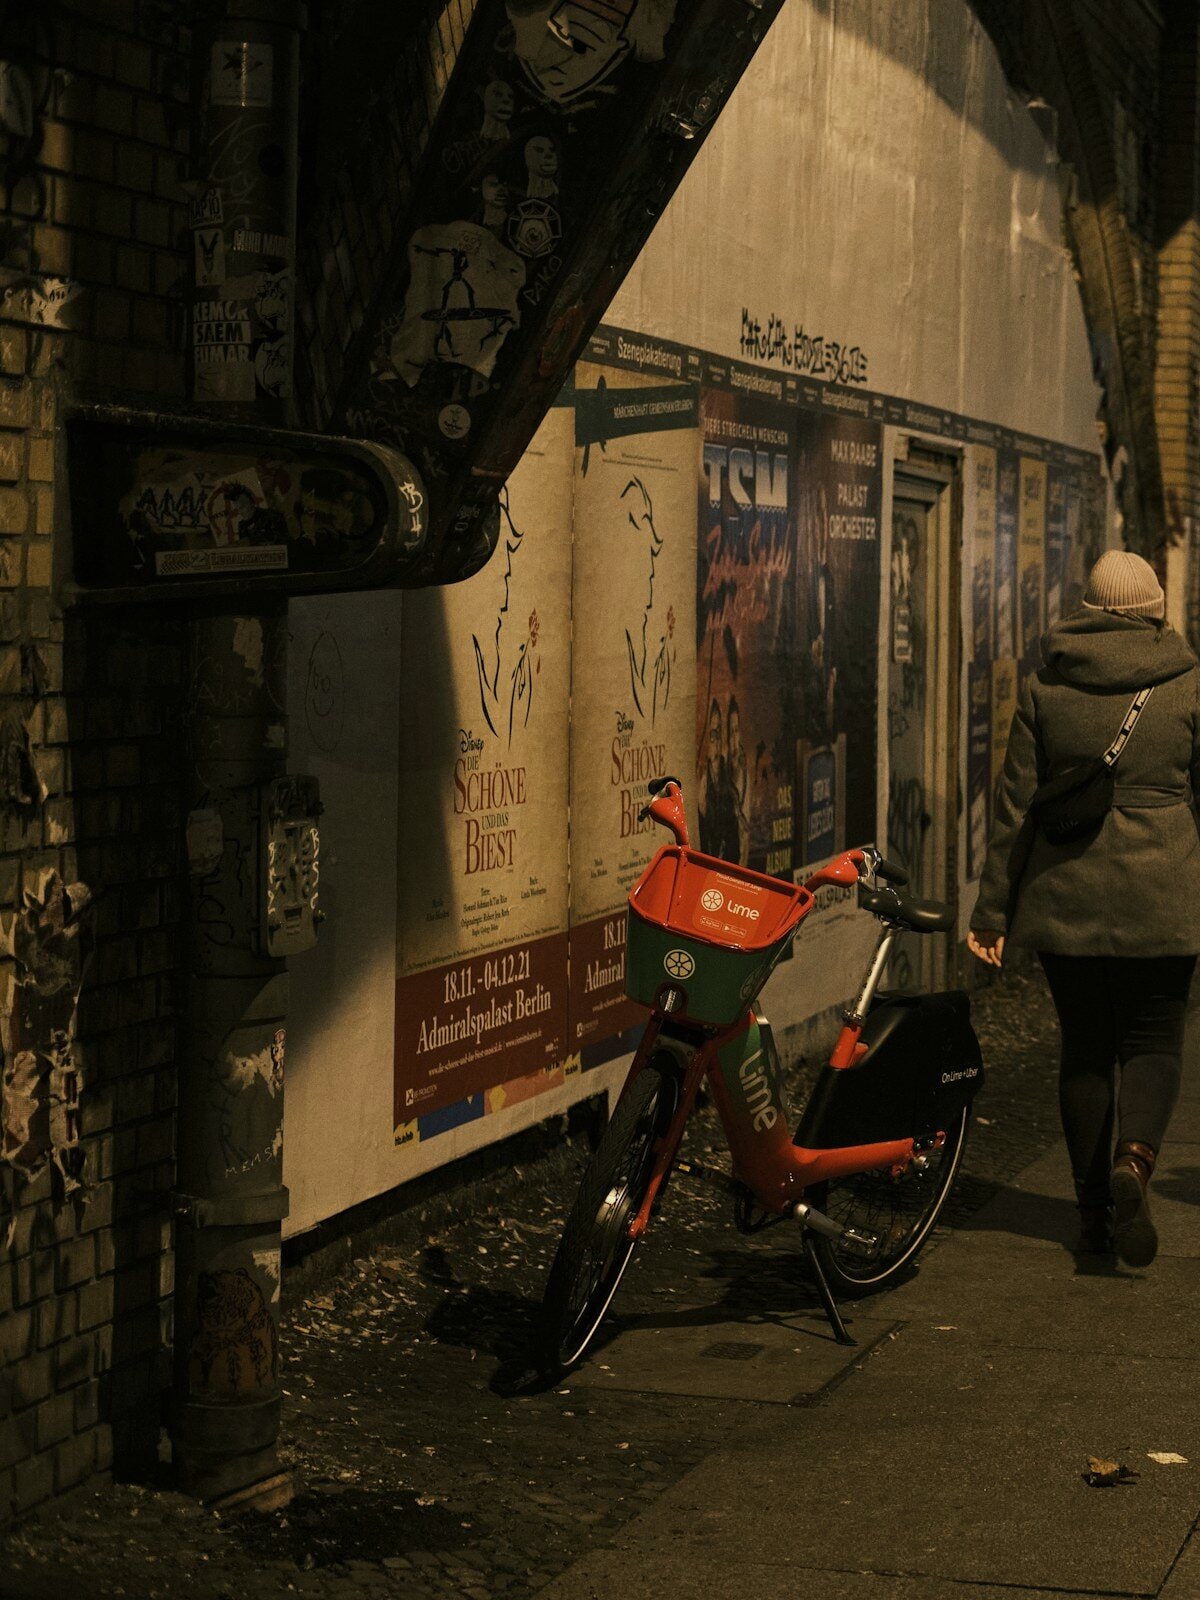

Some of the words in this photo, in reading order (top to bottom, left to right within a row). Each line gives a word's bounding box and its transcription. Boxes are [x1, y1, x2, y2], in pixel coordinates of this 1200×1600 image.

[617, 335, 682, 376] Szeneplakatierung
[722, 421, 757, 441] STREICHELN
[758, 428, 789, 446] MENSCHEN
[831, 439, 850, 464] MAX
[850, 443, 877, 467] RAABE
[704, 442, 788, 508] TSM
[837, 483, 868, 508] PALAST
[829, 514, 877, 541] ORCHESTER
[458, 729, 484, 760] Disney
[466, 755, 479, 771] DIE
[611, 737, 666, 786] SCHÖNE
[454, 758, 526, 814] SCHÖNE
[481, 815, 496, 831] UND
[496, 812, 509, 829] DAS
[464, 819, 517, 875] BIEST
[727, 900, 760, 920] Lime
[416, 997, 513, 1055] Admiralspalast
[516, 983, 551, 1020] Berlin
[738, 1049, 778, 1132] Lime
